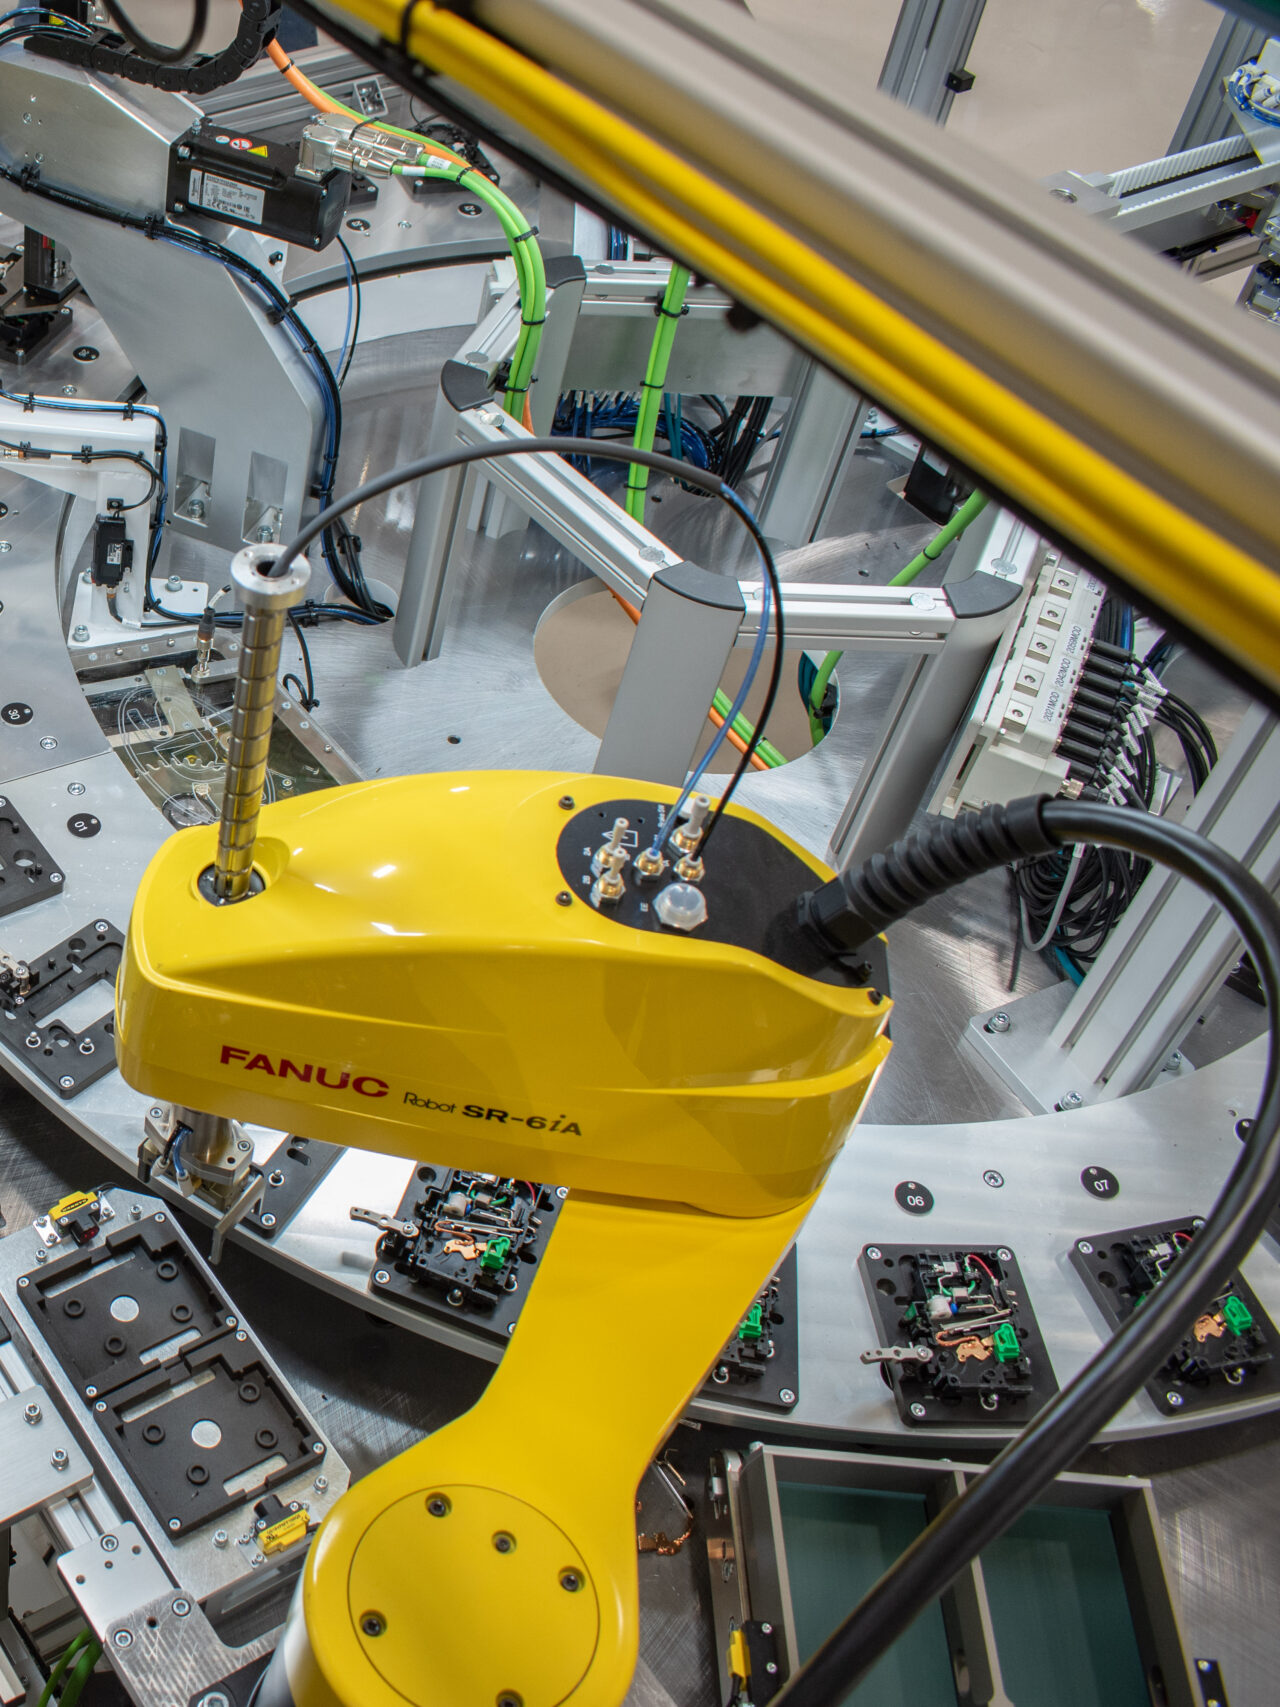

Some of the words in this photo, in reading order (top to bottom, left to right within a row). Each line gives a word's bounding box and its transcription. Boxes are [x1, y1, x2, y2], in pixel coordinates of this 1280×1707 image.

[1043, 691, 1060, 722] 2021MOD
[8, 709, 21, 720] 30
[74, 820, 88, 832] 01
[220, 1045, 390, 1098] FANUC
[403, 1092, 458, 1114] Robot
[461, 1104, 583, 1137] SR-6iA
[1093, 1179, 1111, 1192] 07
[906, 1195, 925, 1207] 06
